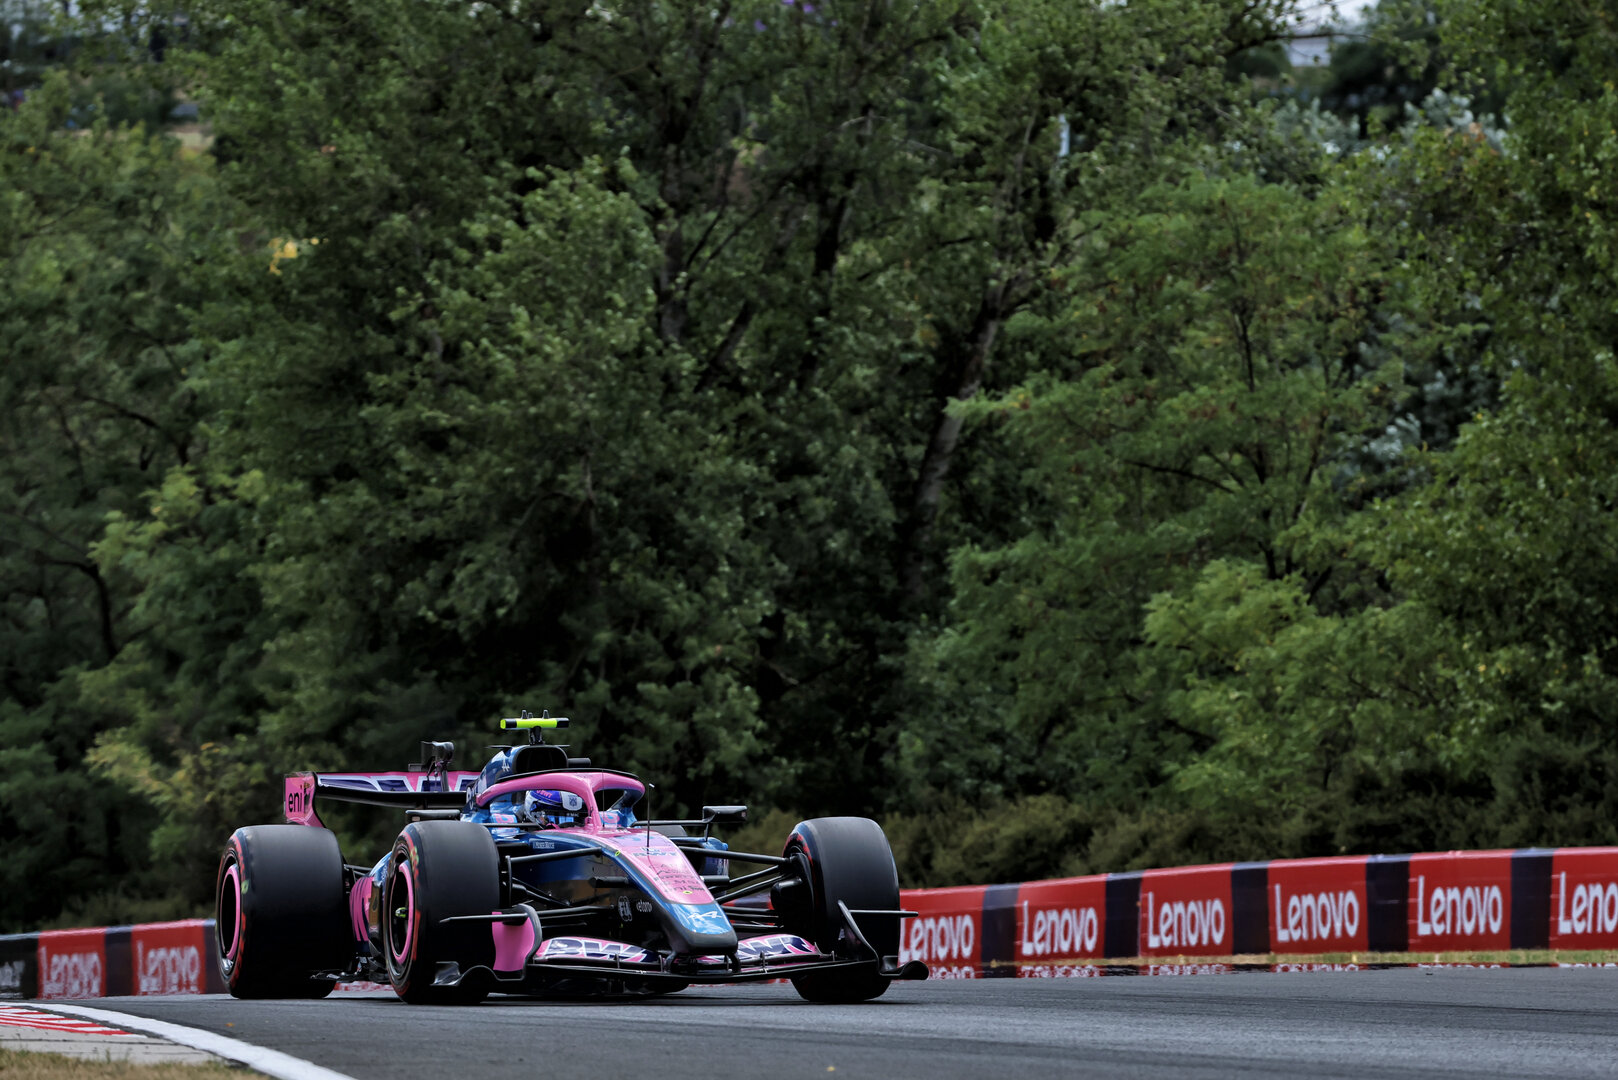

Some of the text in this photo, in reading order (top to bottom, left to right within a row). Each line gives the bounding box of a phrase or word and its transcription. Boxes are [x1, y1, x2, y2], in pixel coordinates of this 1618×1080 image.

[288, 784, 303, 813] eni
[1022, 901, 1099, 957] Lenovo
[1147, 891, 1226, 949] Lenovo
[1275, 883, 1360, 943] Lenovo
[1416, 875, 1503, 936] Lenovo
[1558, 871, 1618, 935] Leno
[899, 909, 976, 964] Lenovo
[40, 945, 102, 995] Lenovo
[136, 940, 200, 993] Lenovo
